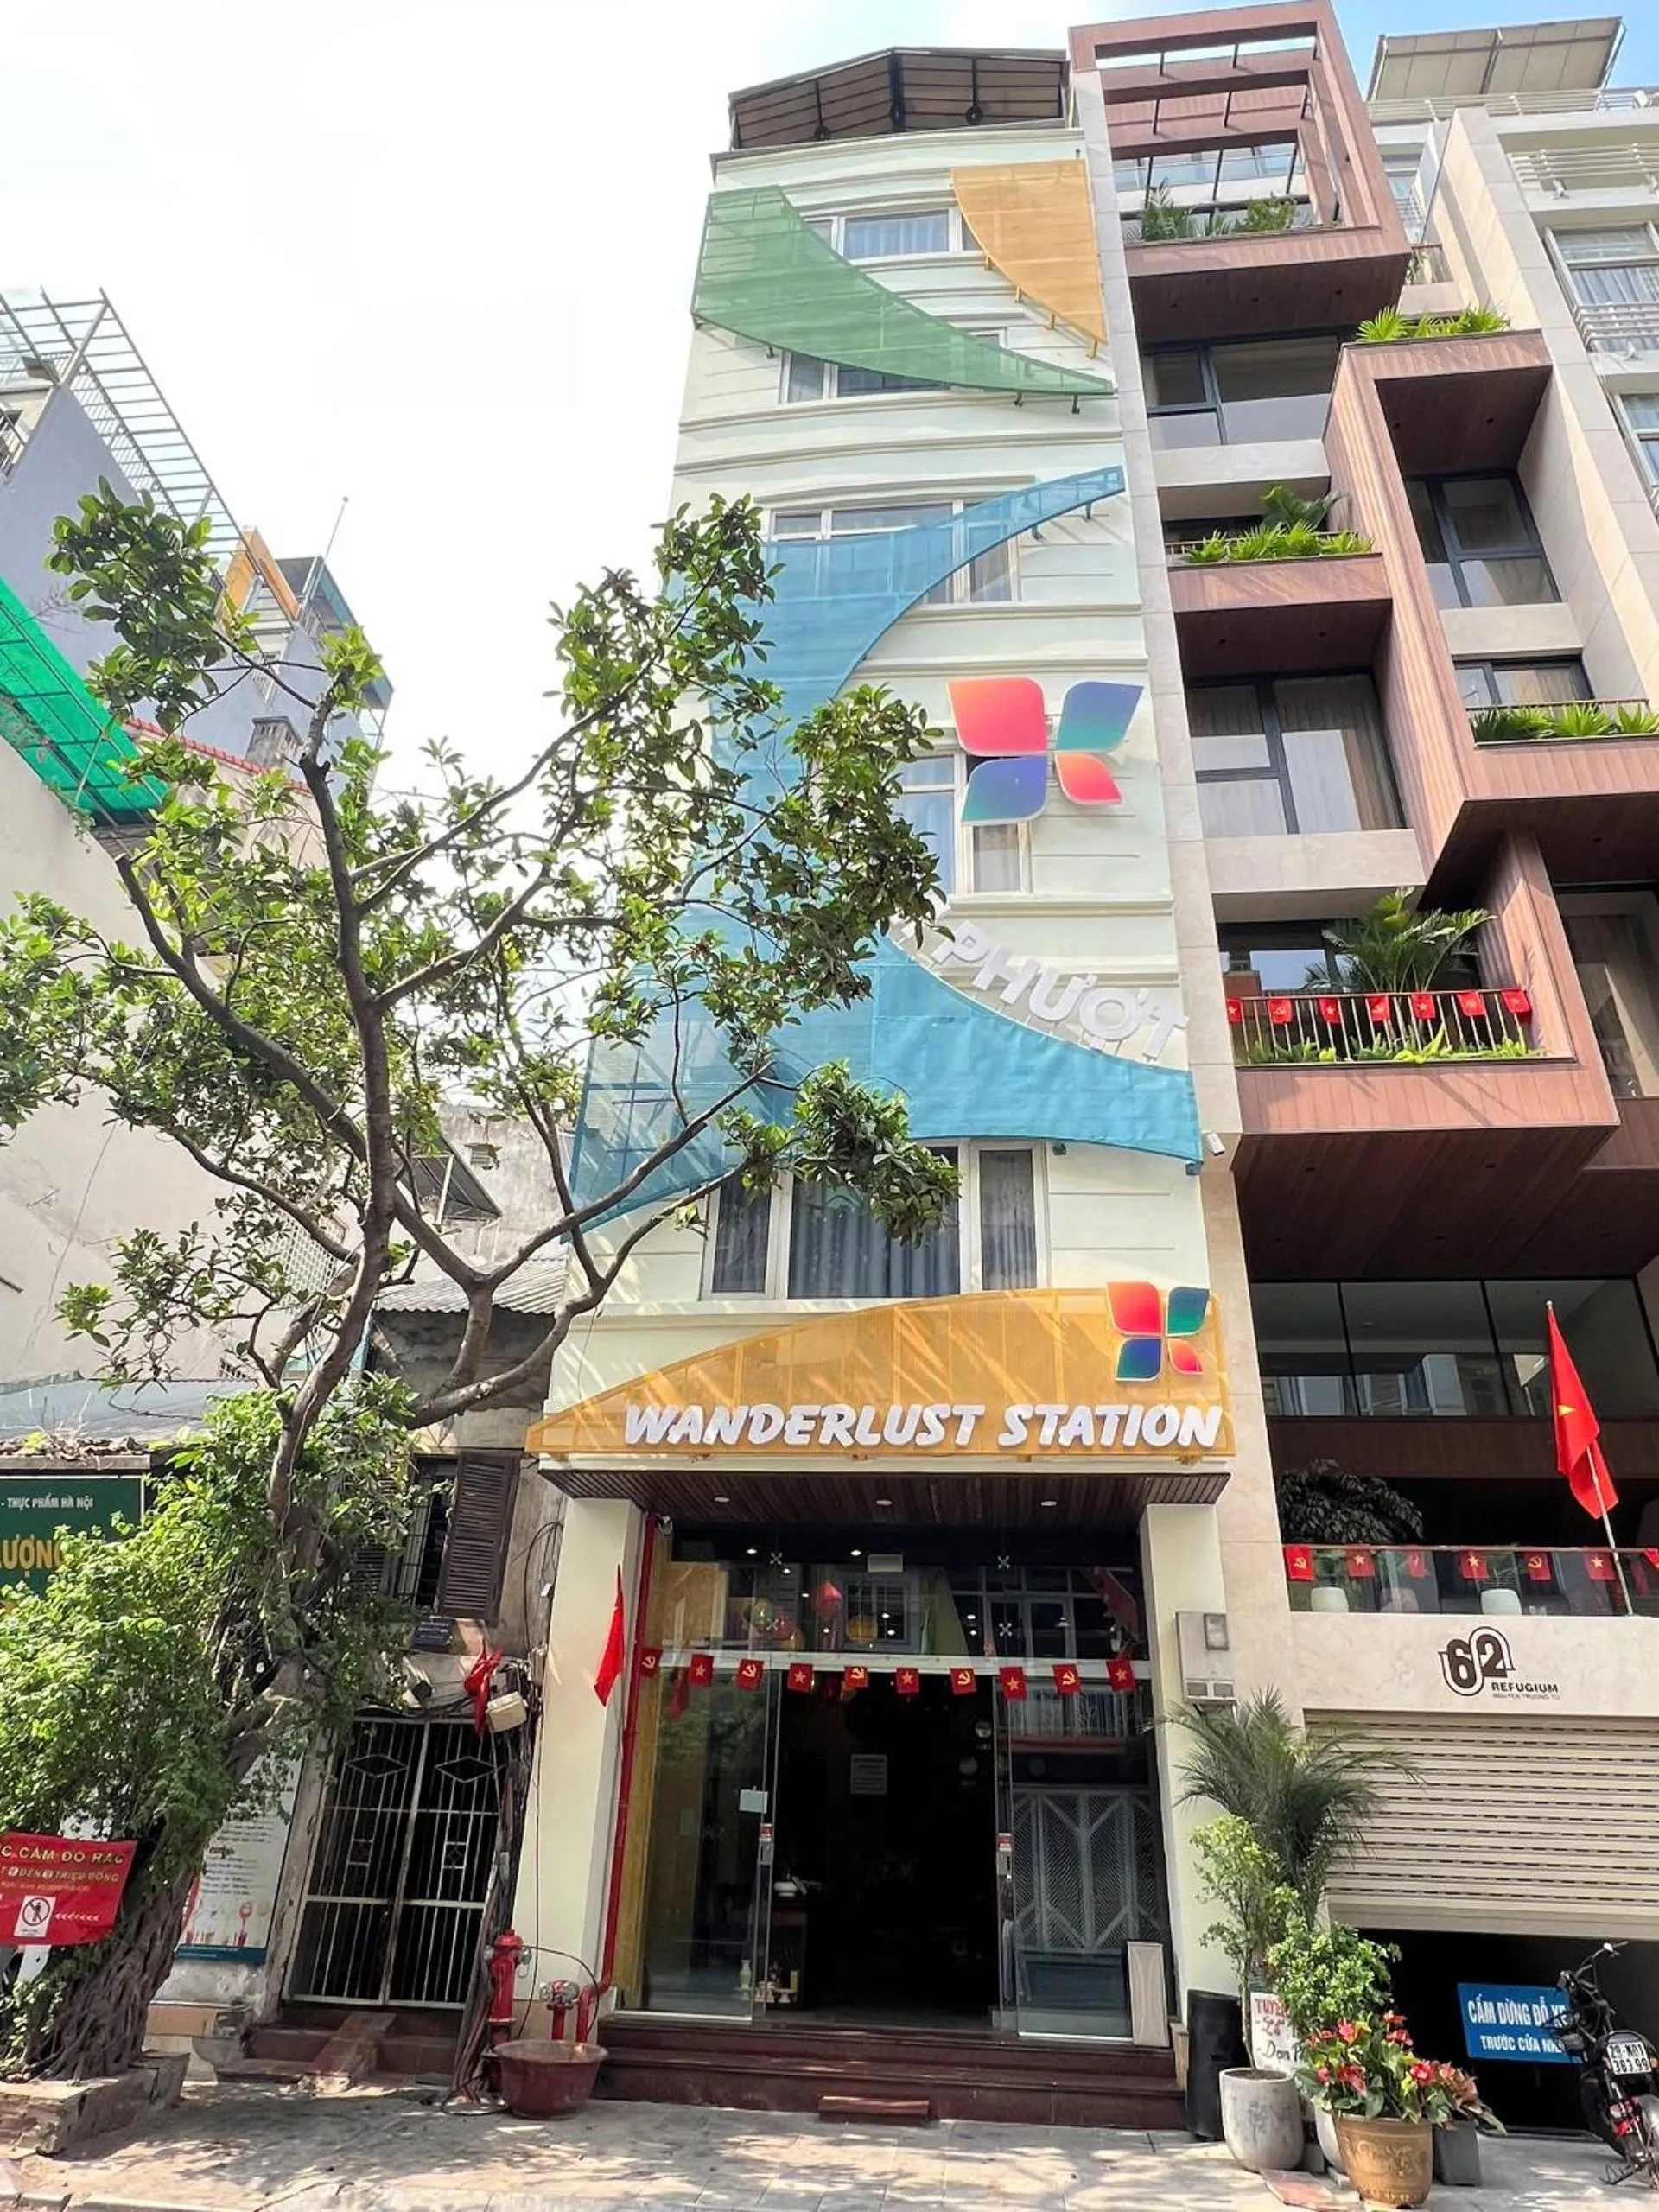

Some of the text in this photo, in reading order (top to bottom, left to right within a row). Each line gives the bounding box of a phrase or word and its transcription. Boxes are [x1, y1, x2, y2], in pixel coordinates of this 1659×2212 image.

[932, 920, 1189, 1061] PHƯỢT
[624, 1403, 1223, 1449] WANDERLUST STATION
[60, 1495, 74, 1508] HÀ
[1445, 1632, 1509, 1690] 62
[1491, 1681, 1559, 1693] REFUGIUM
[1468, 1993, 1497, 2024] CẤM
[1497, 1998, 1532, 2025] DỪNG
[1480, 2033, 1516, 2051] TRƯỚC
[1517, 2033, 1541, 2053] CỬA
